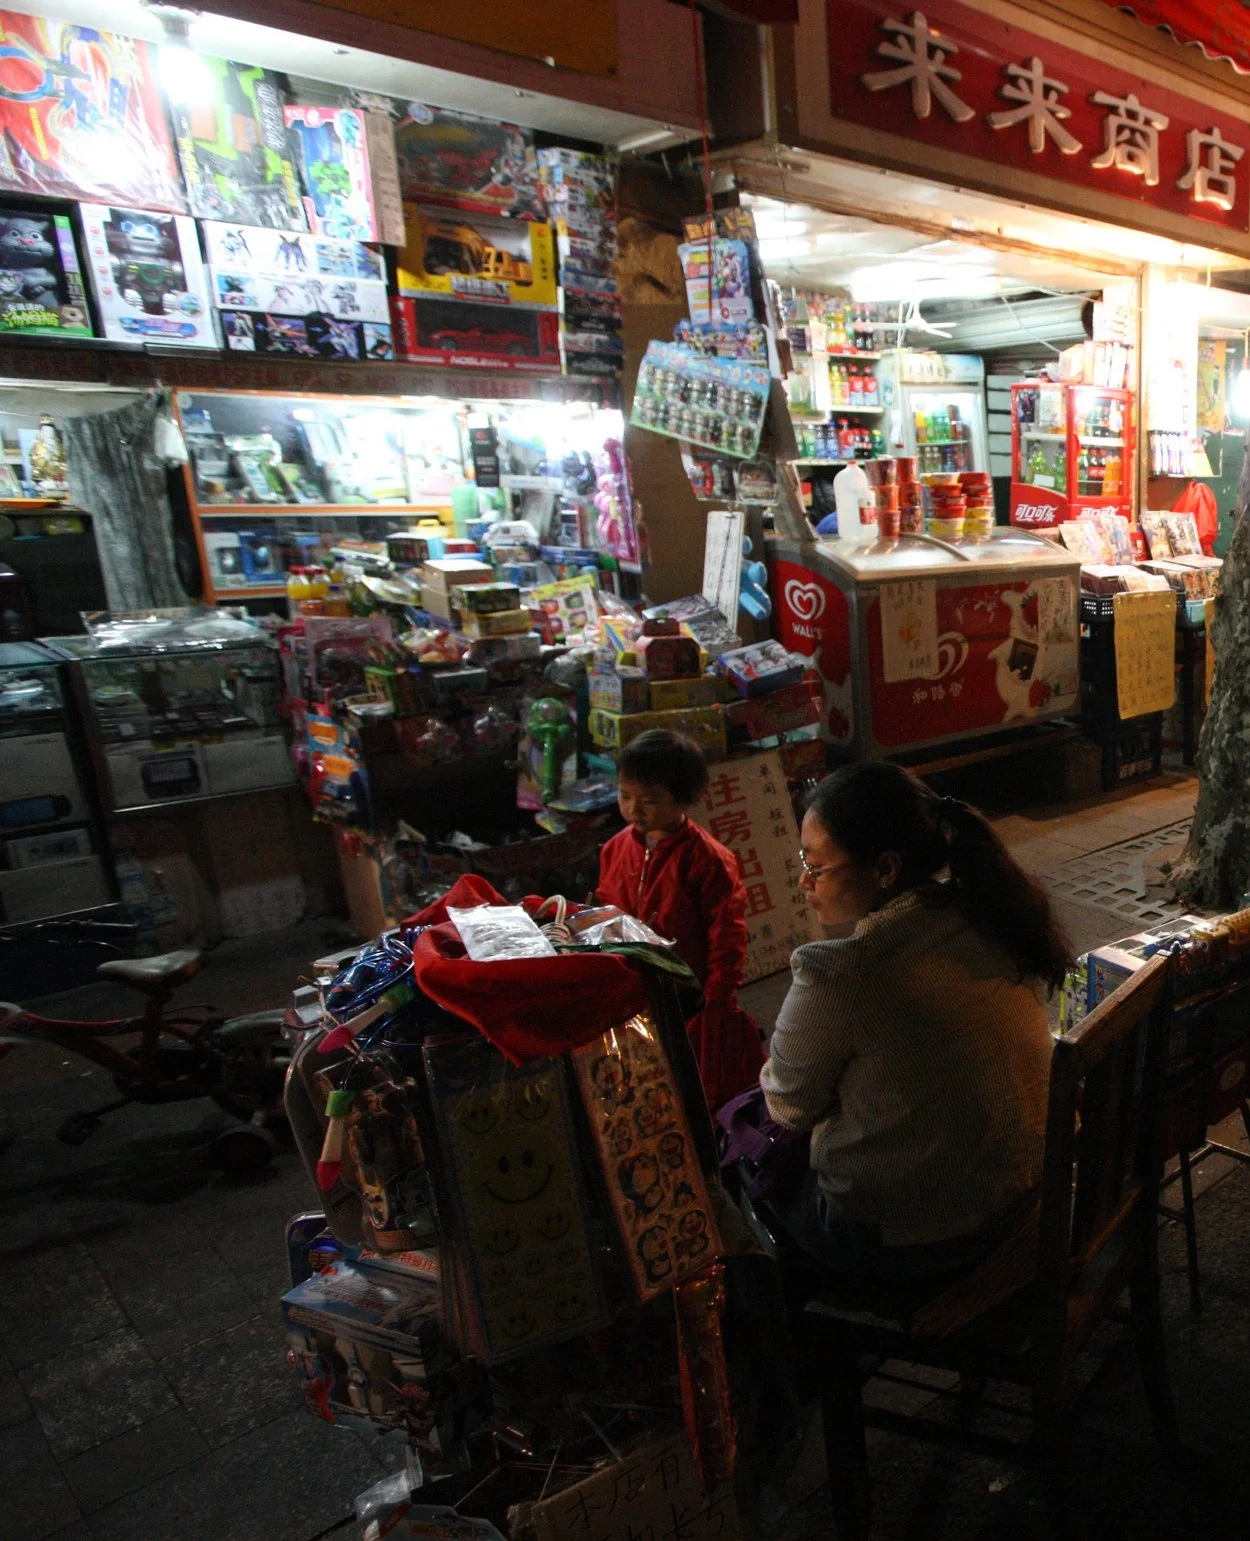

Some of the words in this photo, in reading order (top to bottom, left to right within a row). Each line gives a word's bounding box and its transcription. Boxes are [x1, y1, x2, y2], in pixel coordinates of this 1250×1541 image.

[861, 10, 1246, 212] 来来商店
[1015, 503, 1058, 523] 可口可乐
